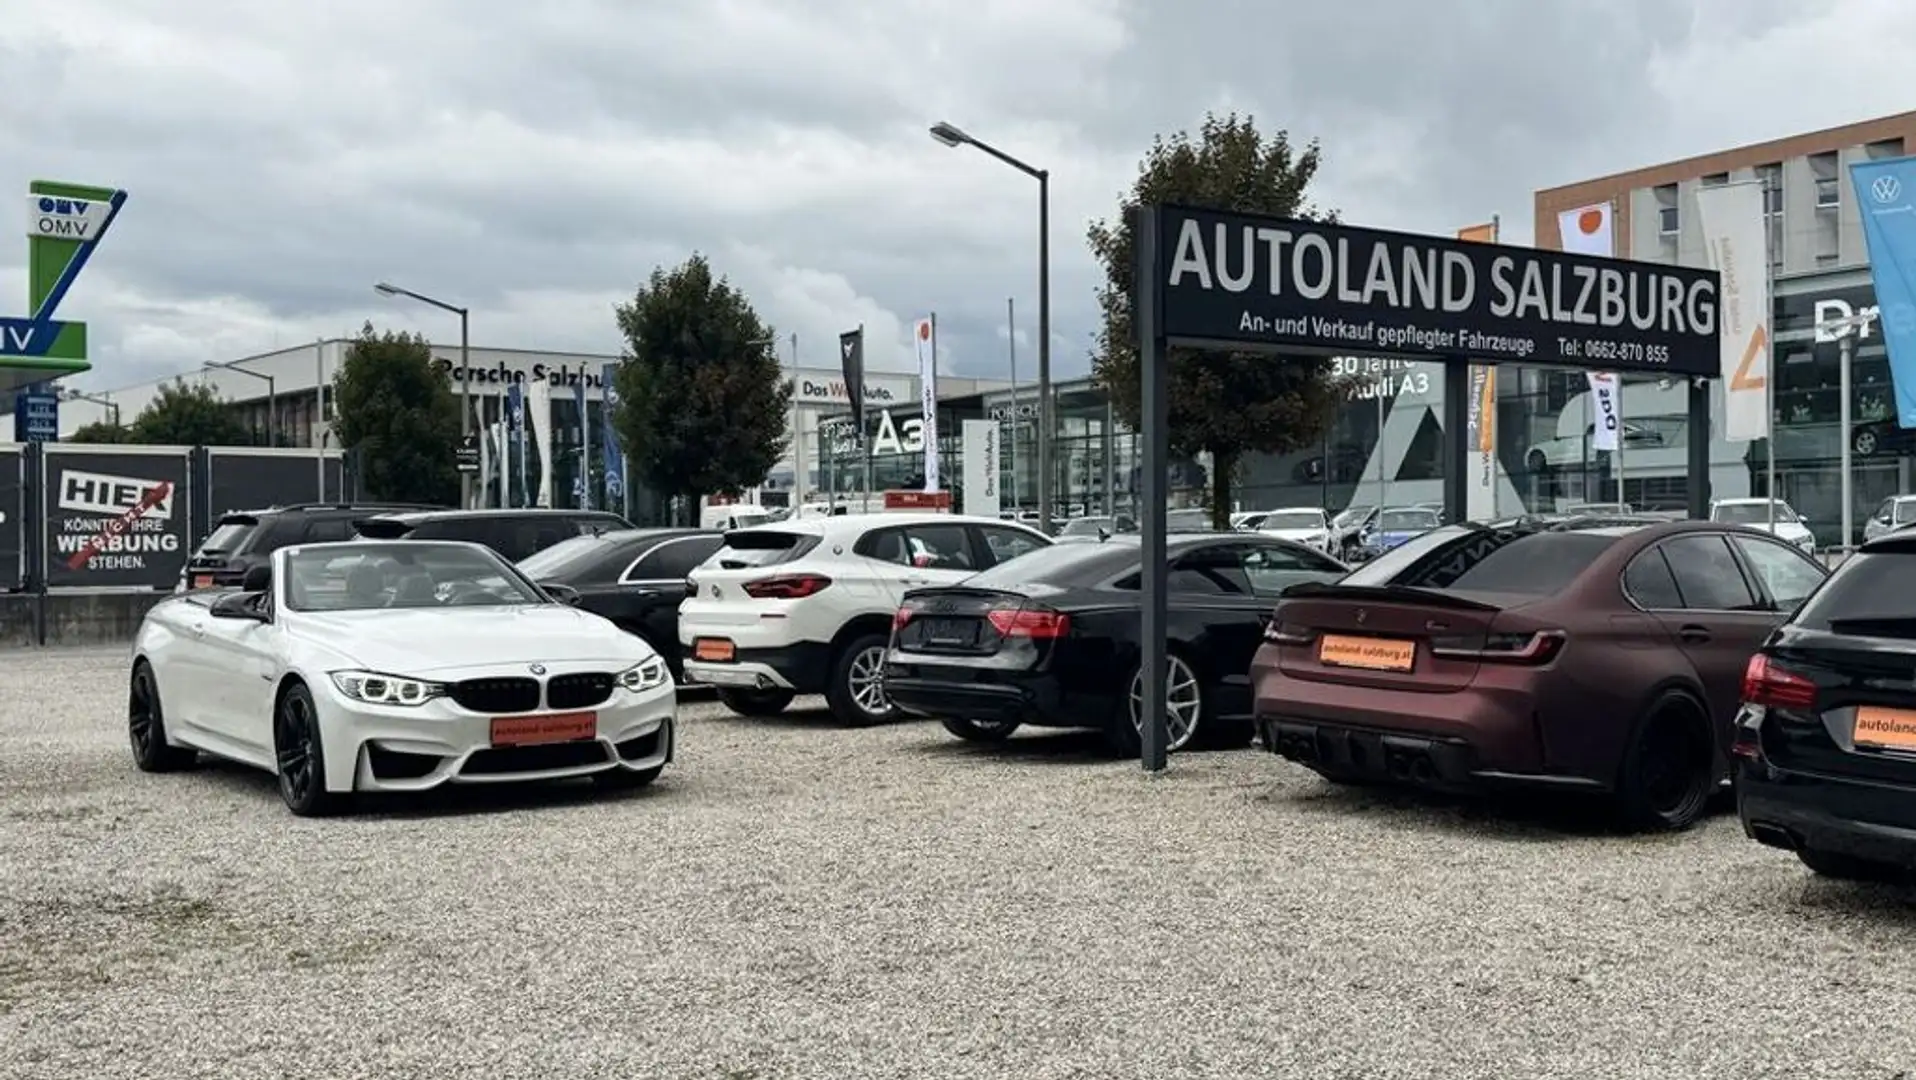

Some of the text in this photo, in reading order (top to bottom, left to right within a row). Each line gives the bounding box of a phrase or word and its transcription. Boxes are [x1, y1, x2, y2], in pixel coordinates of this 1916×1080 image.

[39, 218, 88, 235] OMV
[1169, 218, 1475, 312] AUTOLAND
[1489, 256, 1715, 335] SALZBURG
[1240, 310, 1669, 363] An- und Verkauf gepflegter Fahrzeuge Tel: 0662-870 855
[440, 359, 604, 388] Porsche Salzbu
[803, 380, 828, 397] Das
[1399, 372, 1429, 396] A3
[131, 519, 164, 531] IHRE
[88, 556, 146, 569] STEHEN.
